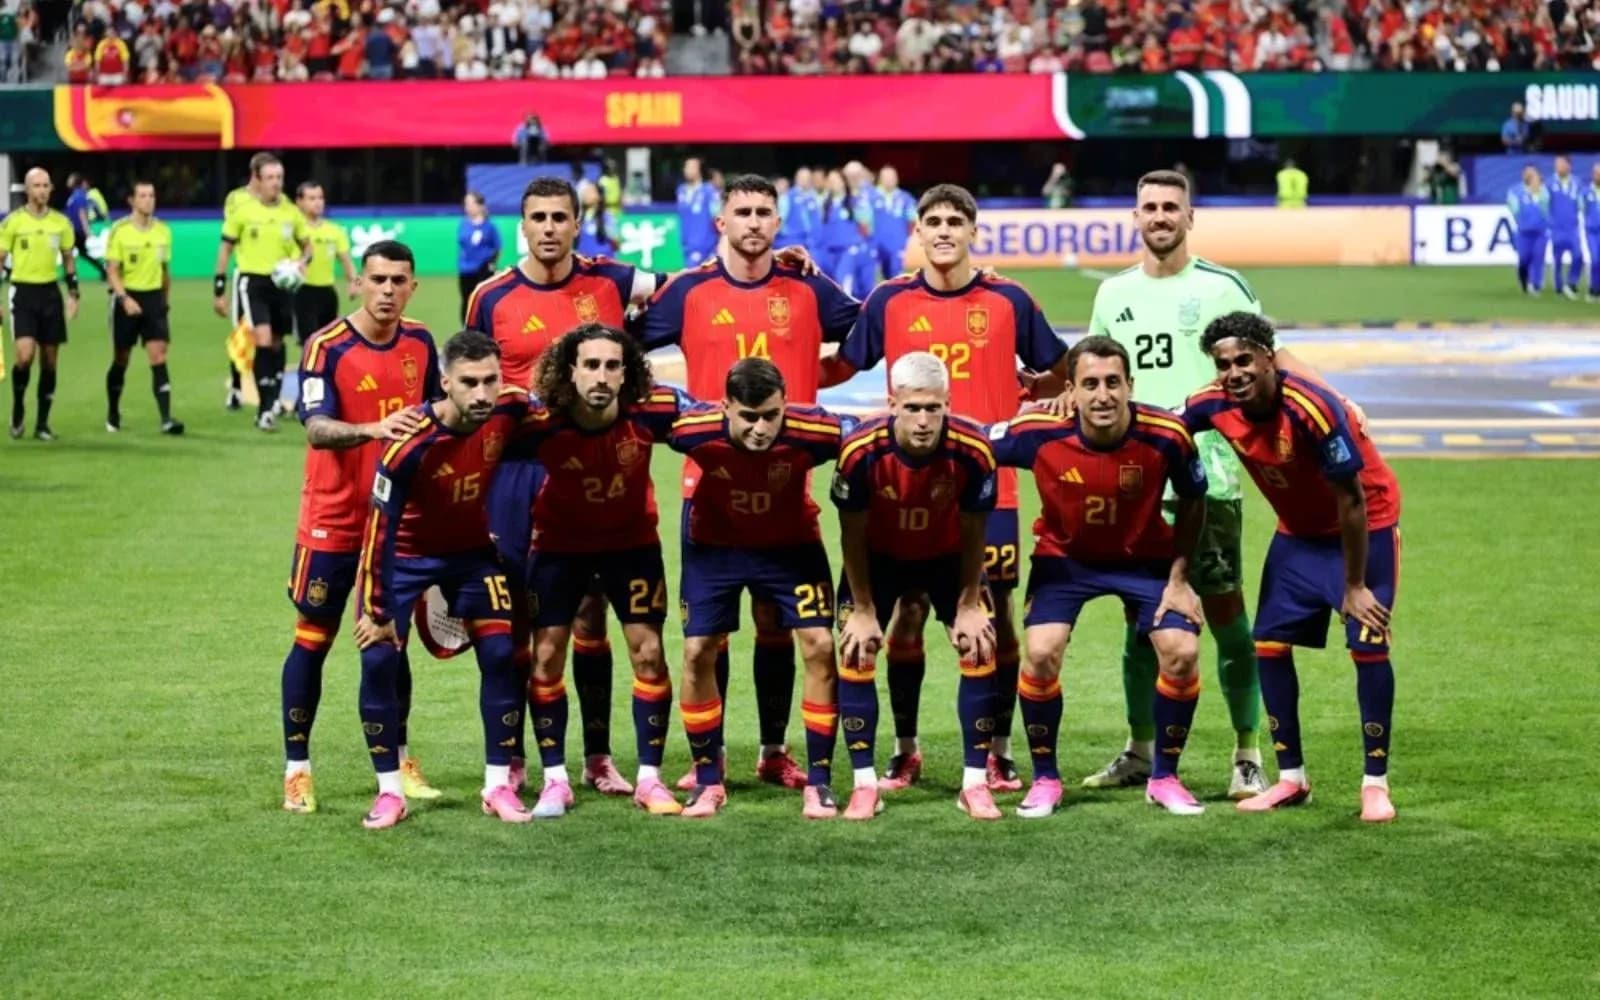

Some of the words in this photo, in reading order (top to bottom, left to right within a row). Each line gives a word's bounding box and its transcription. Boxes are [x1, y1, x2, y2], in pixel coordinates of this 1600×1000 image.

[606, 91, 683, 127] SPAIN
[1525, 83, 1599, 120] SAUDI
[736, 332, 771, 360] 14
[1134, 333, 1171, 369] 23
[451, 472, 480, 503] 15
[583, 473, 627, 503] 24
[730, 489, 771, 514] 20
[898, 507, 928, 530] 10
[1085, 496, 1117, 525] 21
[483, 575, 511, 611] 15
